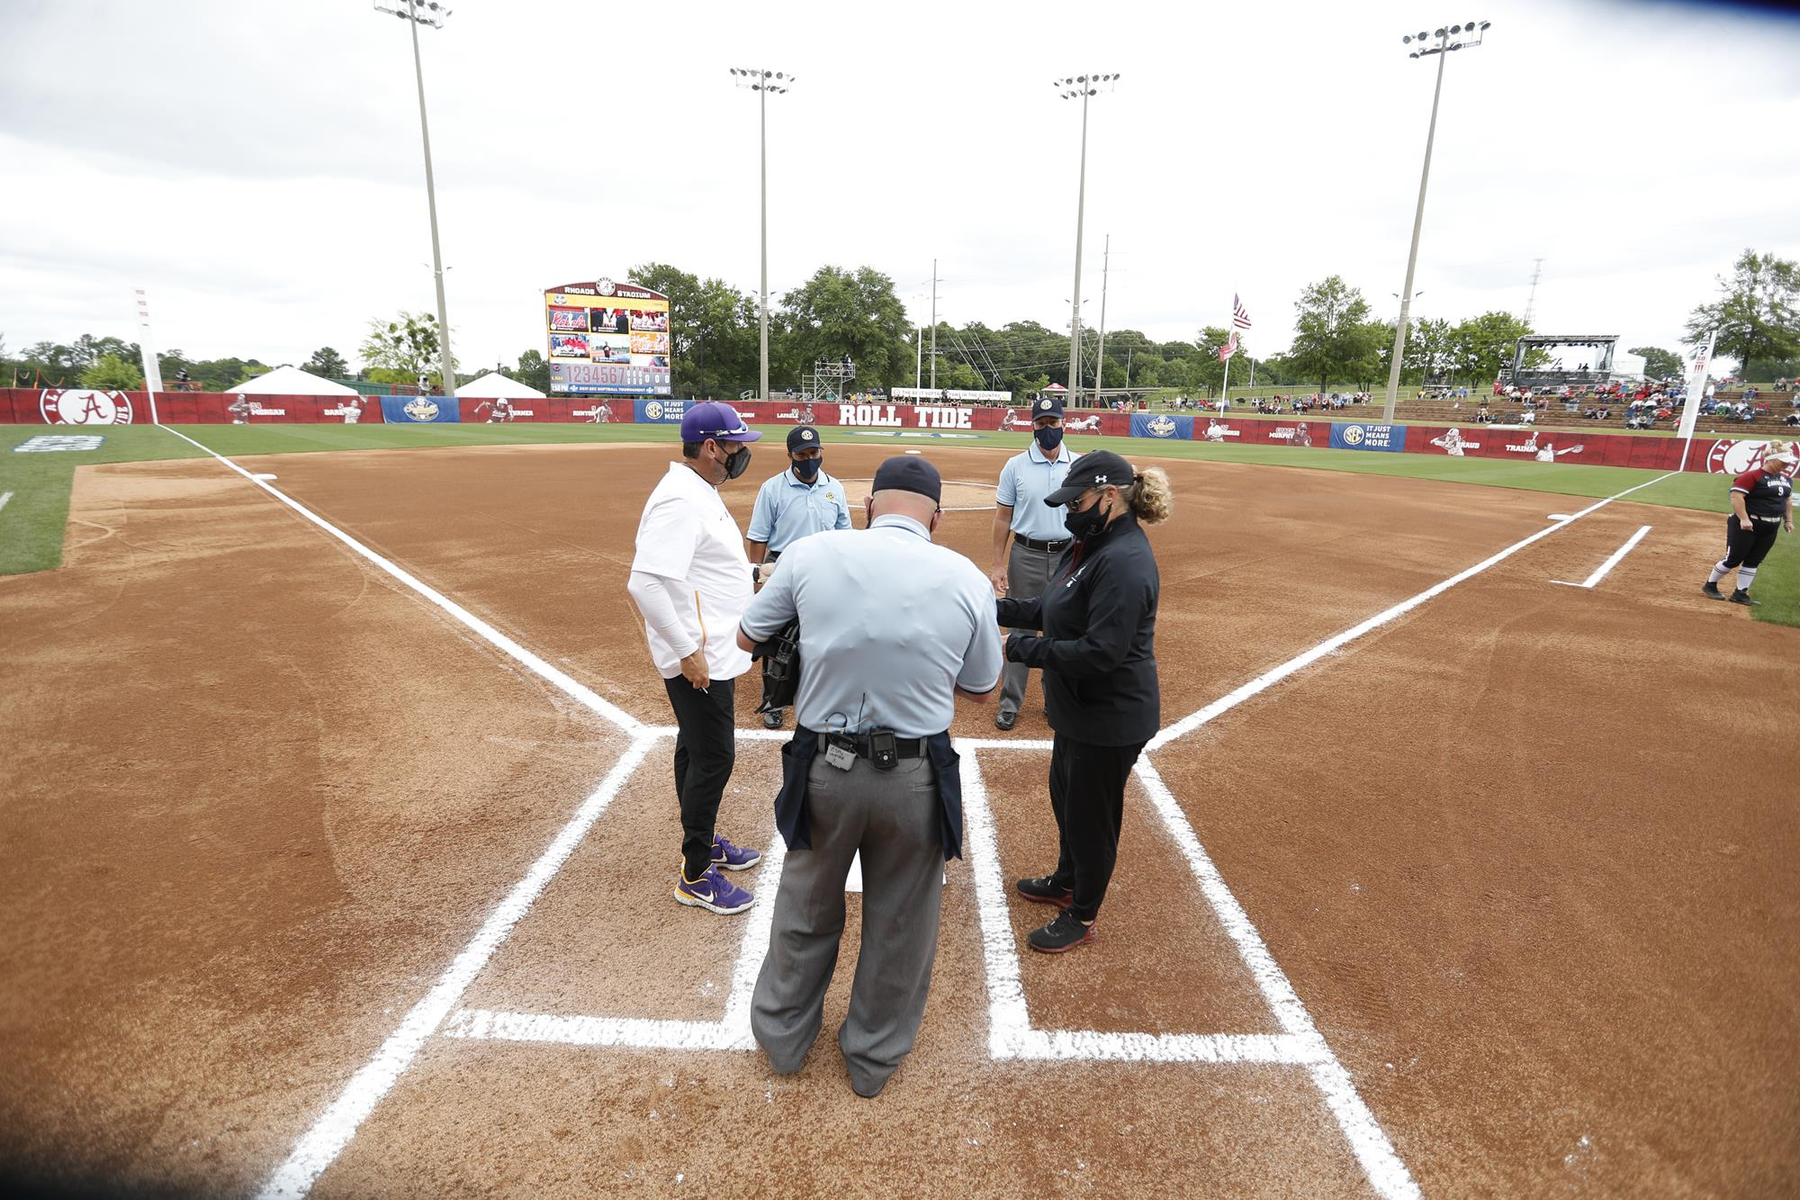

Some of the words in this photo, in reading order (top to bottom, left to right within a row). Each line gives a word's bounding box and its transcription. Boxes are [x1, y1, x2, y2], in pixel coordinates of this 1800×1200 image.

[565, 287, 595, 295] RHOADS
[839, 404, 902, 426] ROLL
[914, 406, 972, 429] TIDE
[1346, 428, 1362, 442] SEC
[1778, 486, 1784, 496] 9
